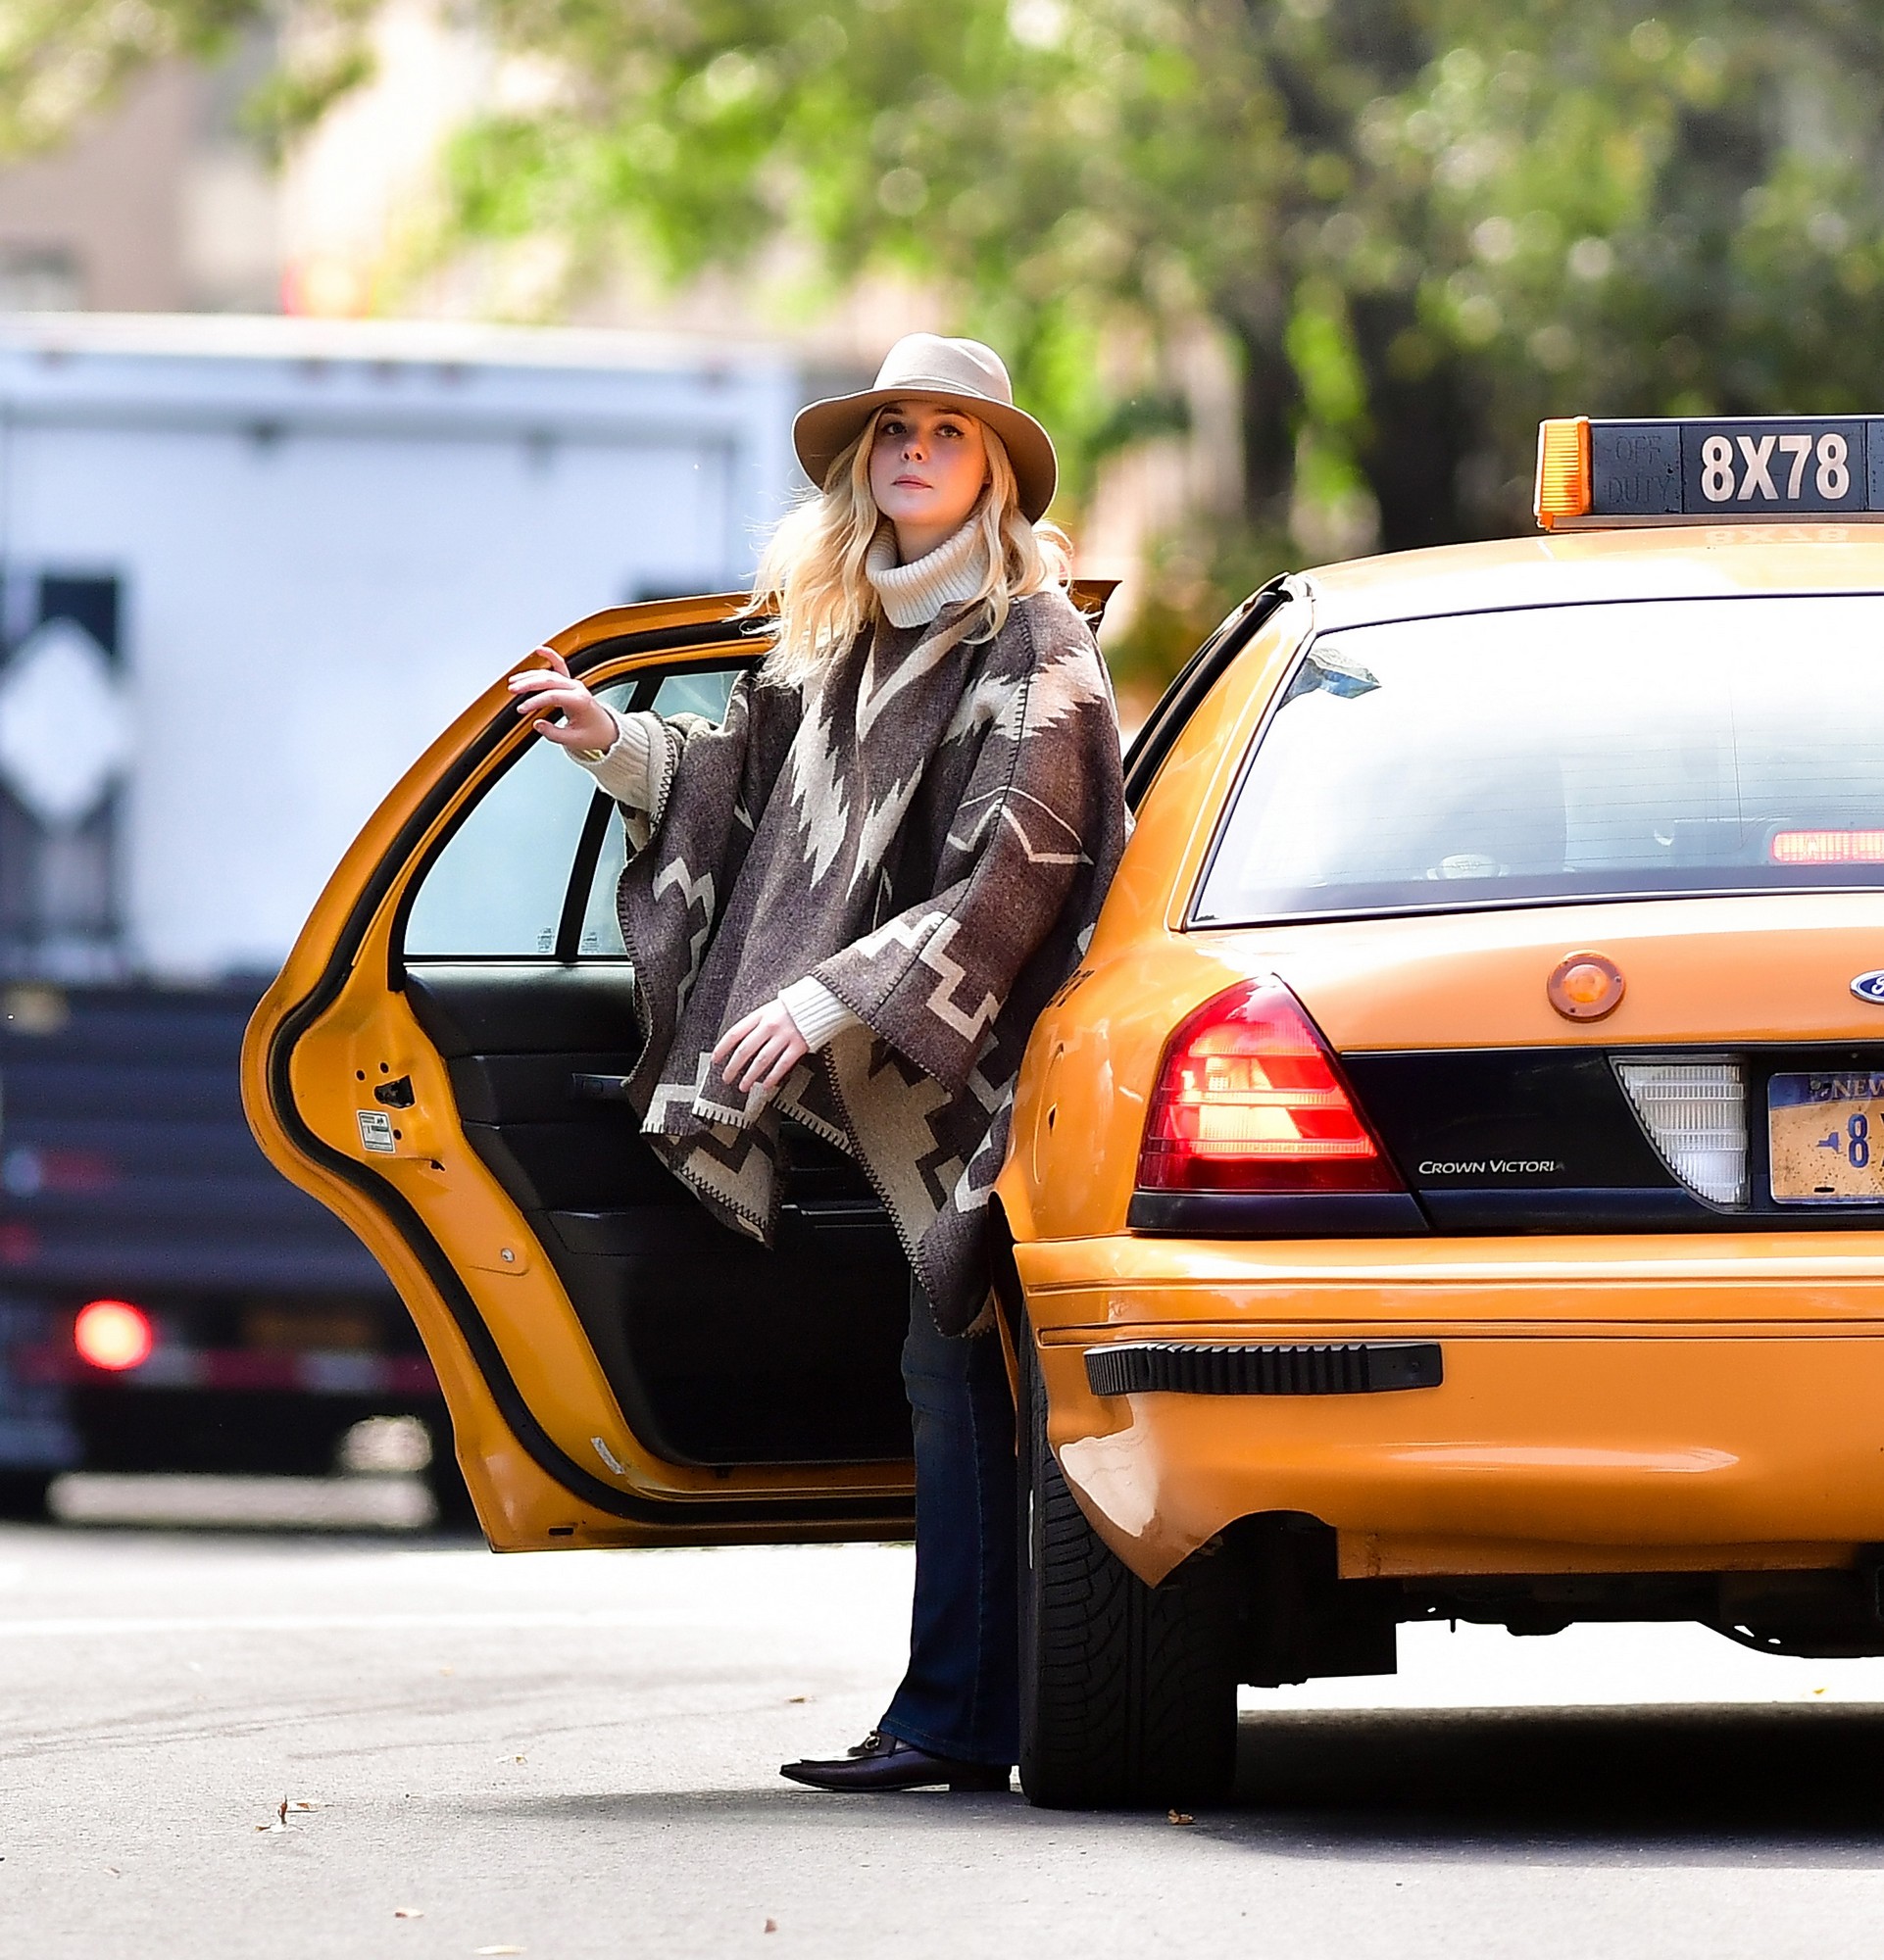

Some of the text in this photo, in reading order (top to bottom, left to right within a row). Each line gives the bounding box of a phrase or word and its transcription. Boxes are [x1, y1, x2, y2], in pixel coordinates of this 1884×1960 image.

[1615, 435, 1661, 465] OFF
[1702, 433, 1850, 502] 8X78
[1609, 474, 1668, 505] DUTY
[1418, 1161, 1486, 1174] CROWN
